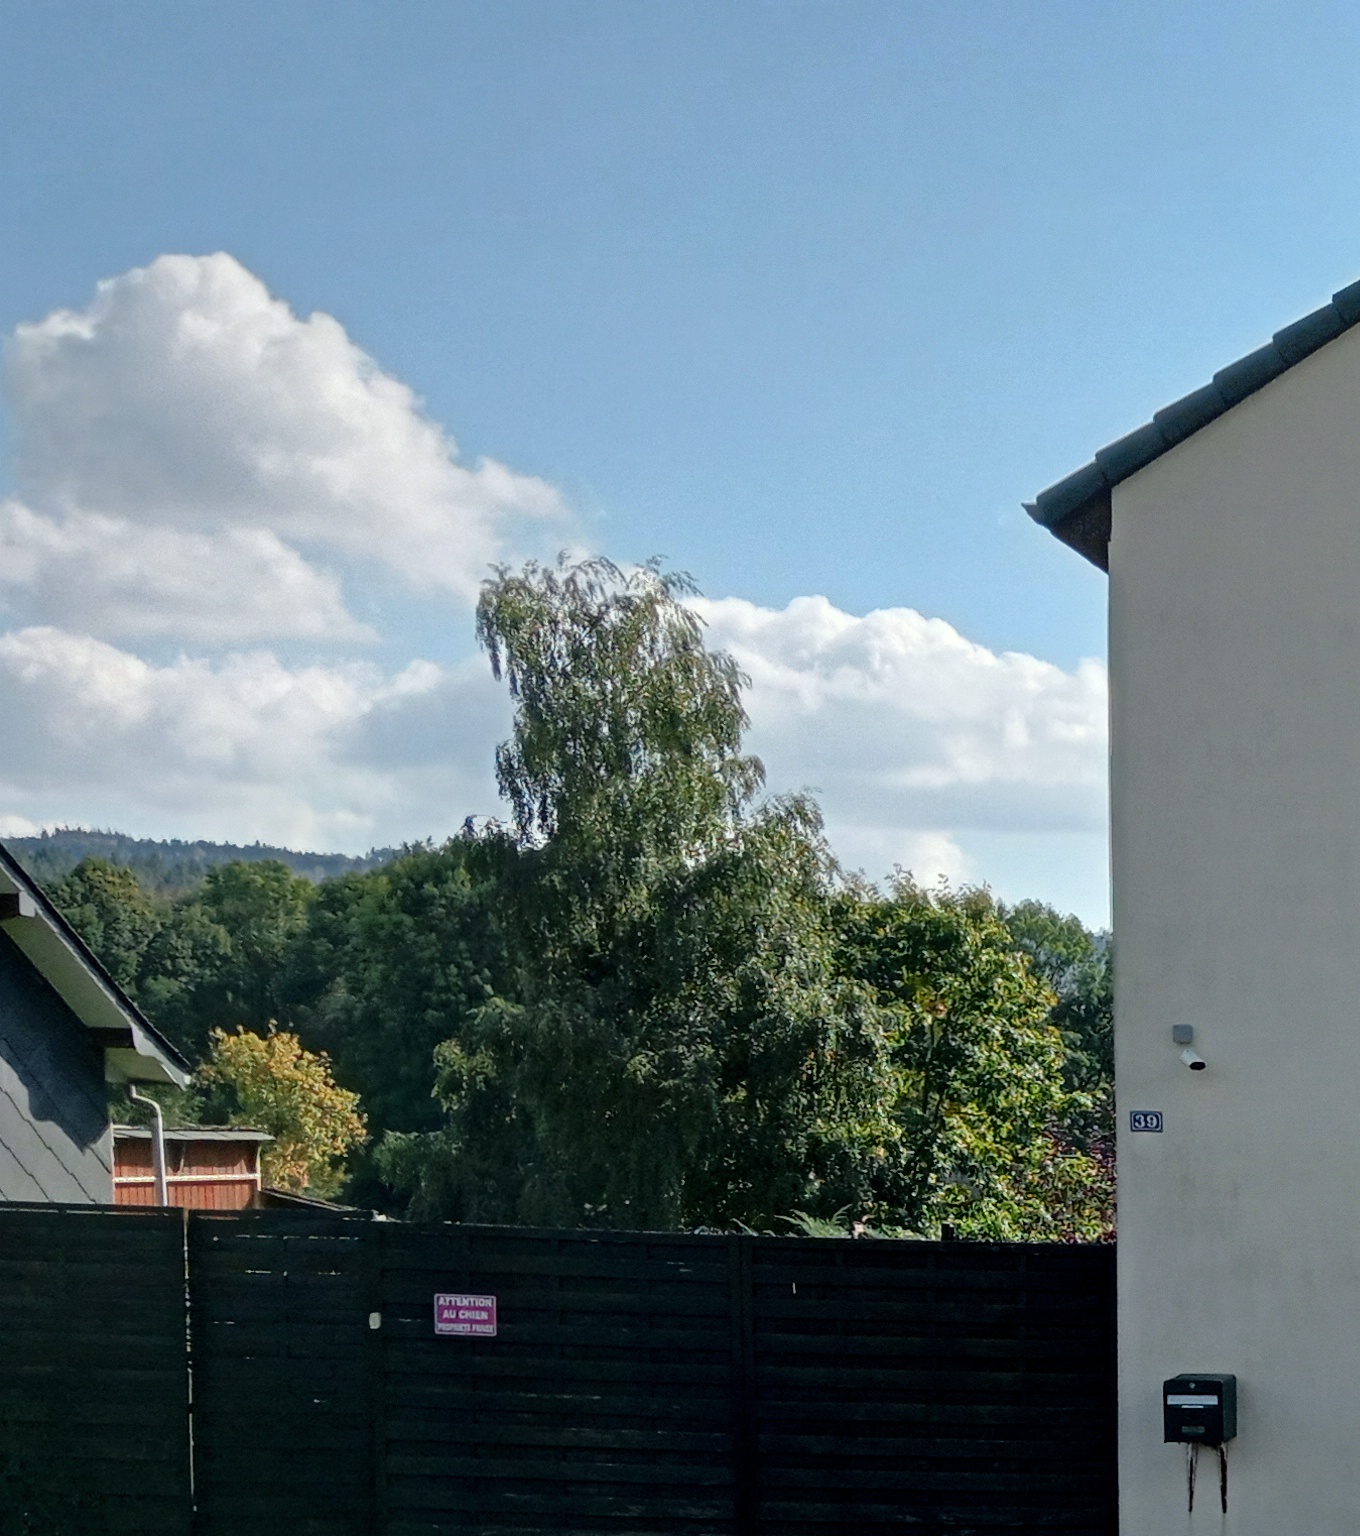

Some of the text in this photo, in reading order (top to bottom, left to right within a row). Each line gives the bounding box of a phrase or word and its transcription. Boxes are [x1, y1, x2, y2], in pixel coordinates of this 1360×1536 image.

[1135, 1115, 1157, 1127] 39
[438, 1296, 492, 1306] ATTENTION
[442, 1309, 488, 1319] AU CHIEN
